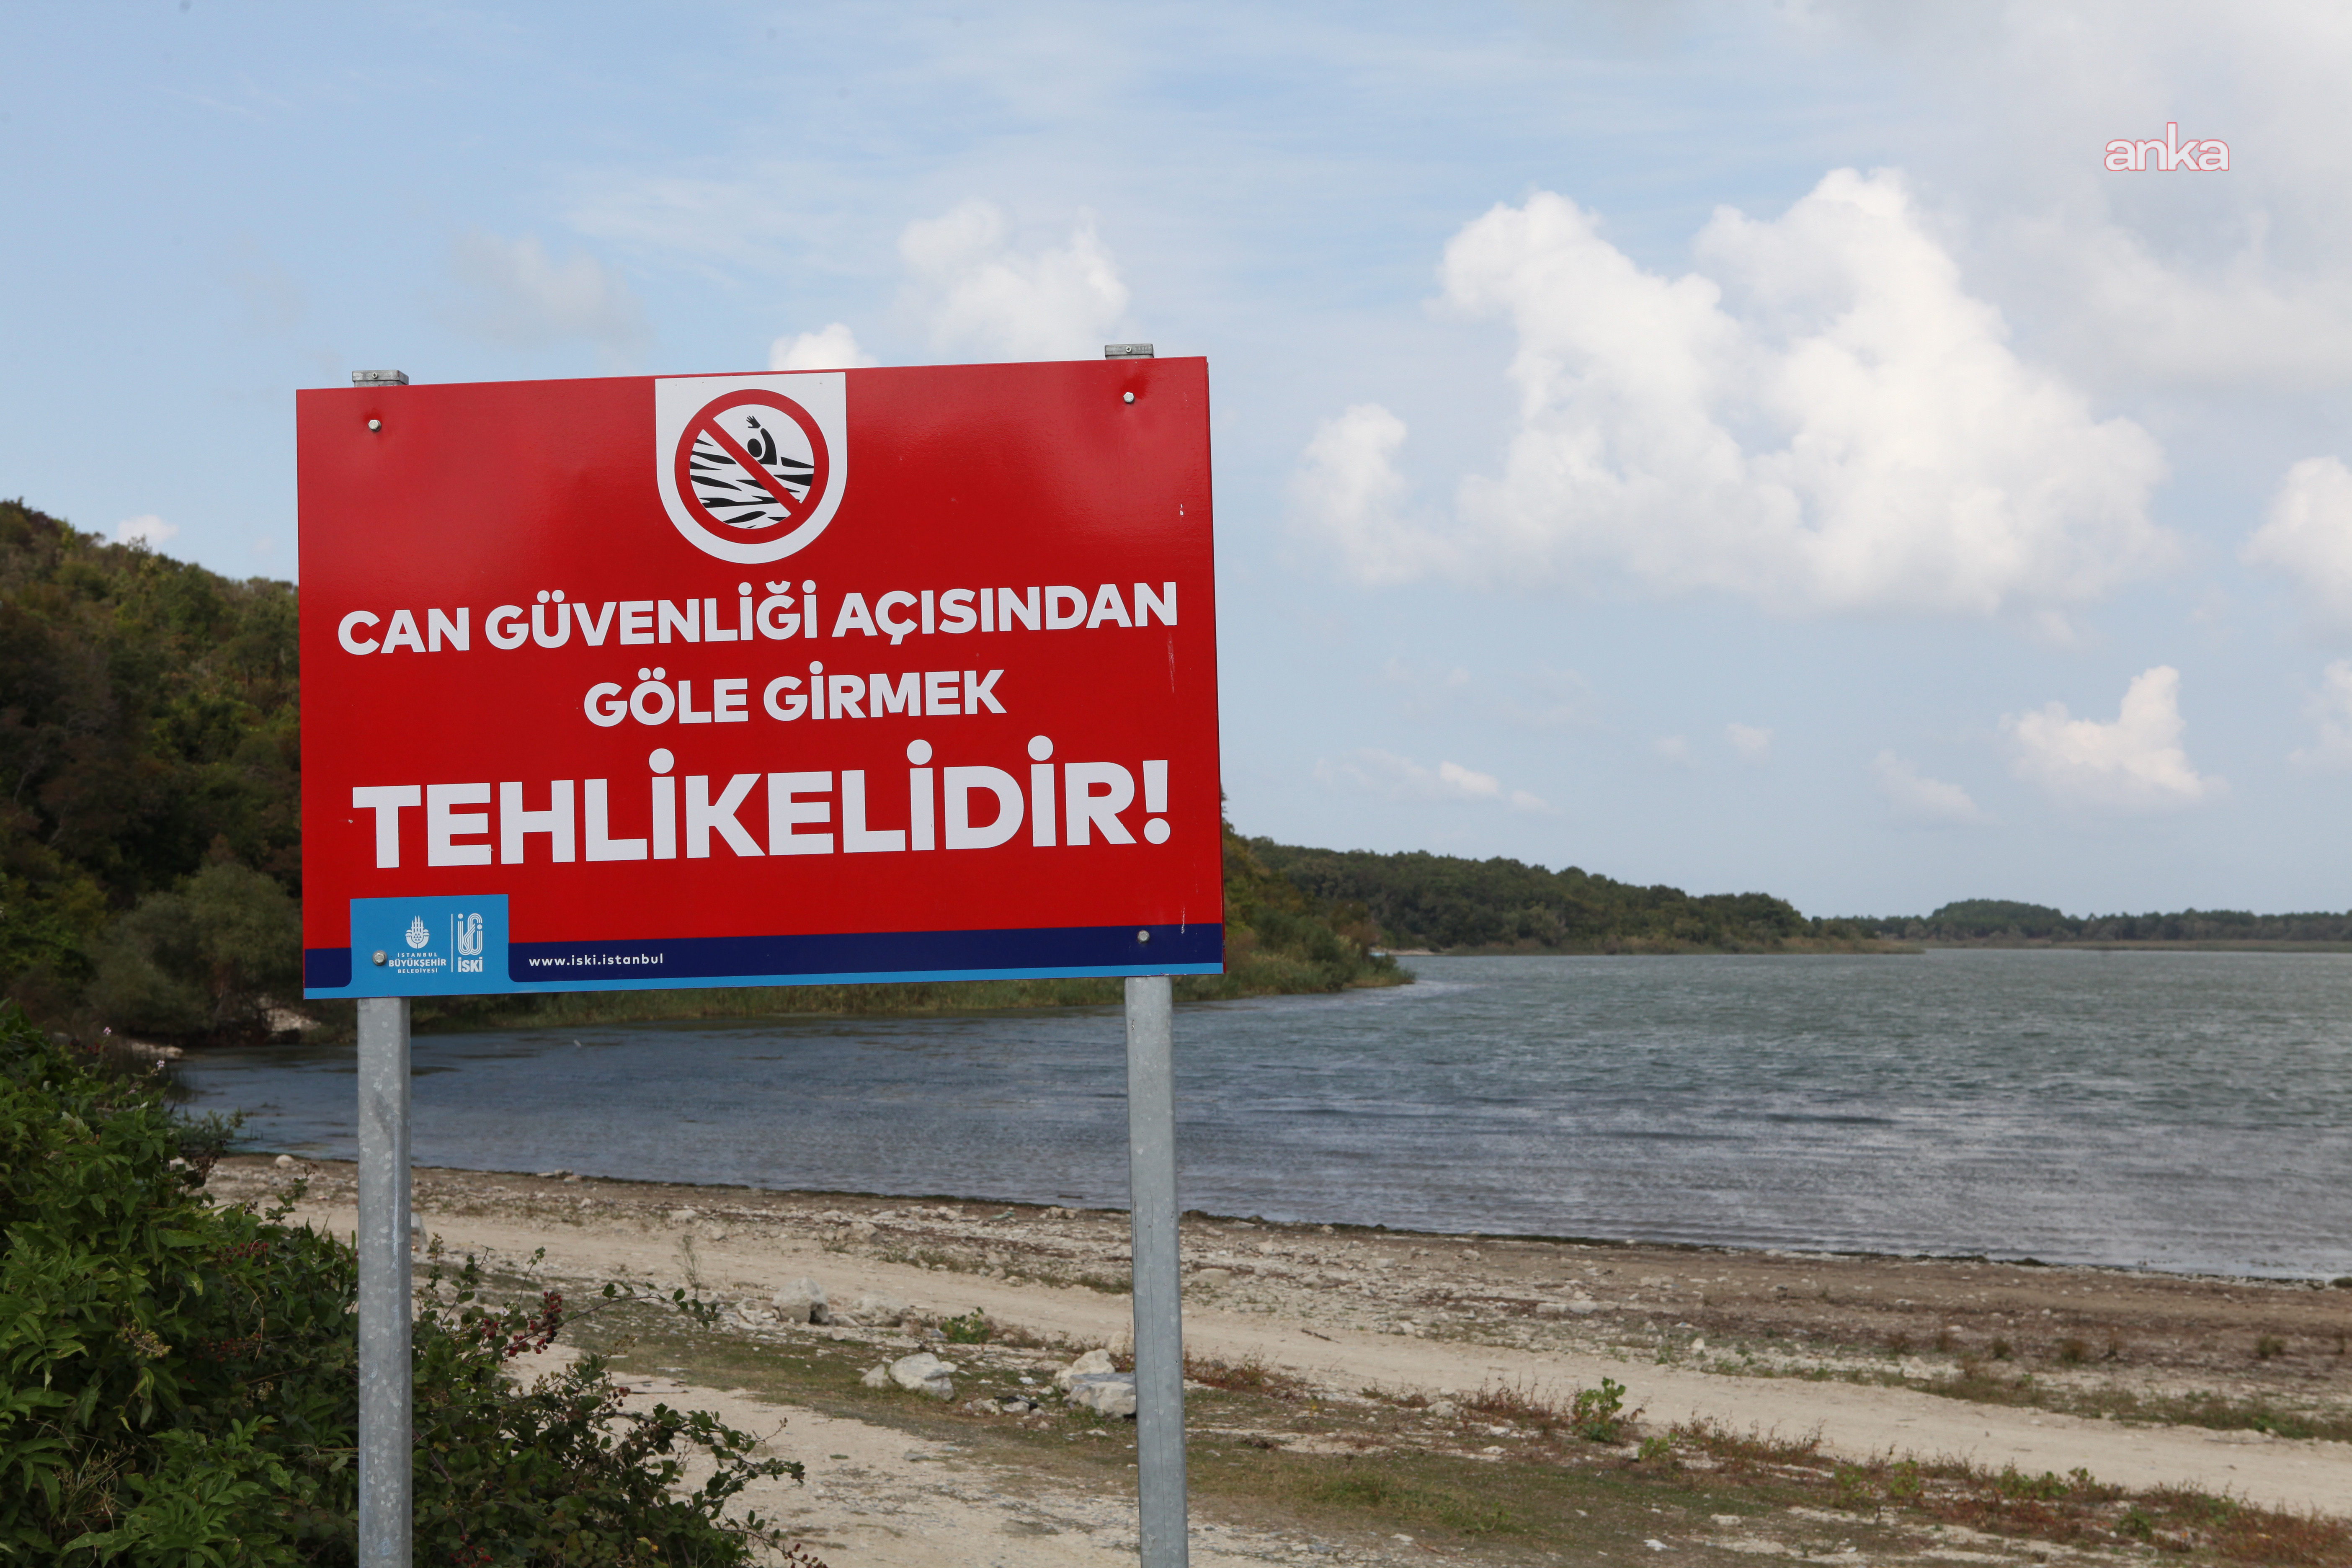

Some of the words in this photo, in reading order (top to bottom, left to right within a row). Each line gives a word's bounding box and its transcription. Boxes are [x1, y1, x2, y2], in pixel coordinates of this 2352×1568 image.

[338, 608, 469, 655] CAN
[485, 580, 817, 650] GÜVENLİĞİ
[832, 582, 1177, 645] AÇISINDAN
[584, 667, 748, 727] GÖLE
[763, 661, 1007, 721] GİRMEK
[353, 735, 1170, 868] TEHLİKELİDİR!
[389, 957, 446, 967] BÜYÜKŞEHİR
[458, 957, 482, 972] İSKİ
[529, 953, 663, 966] www.iski.istanbul
